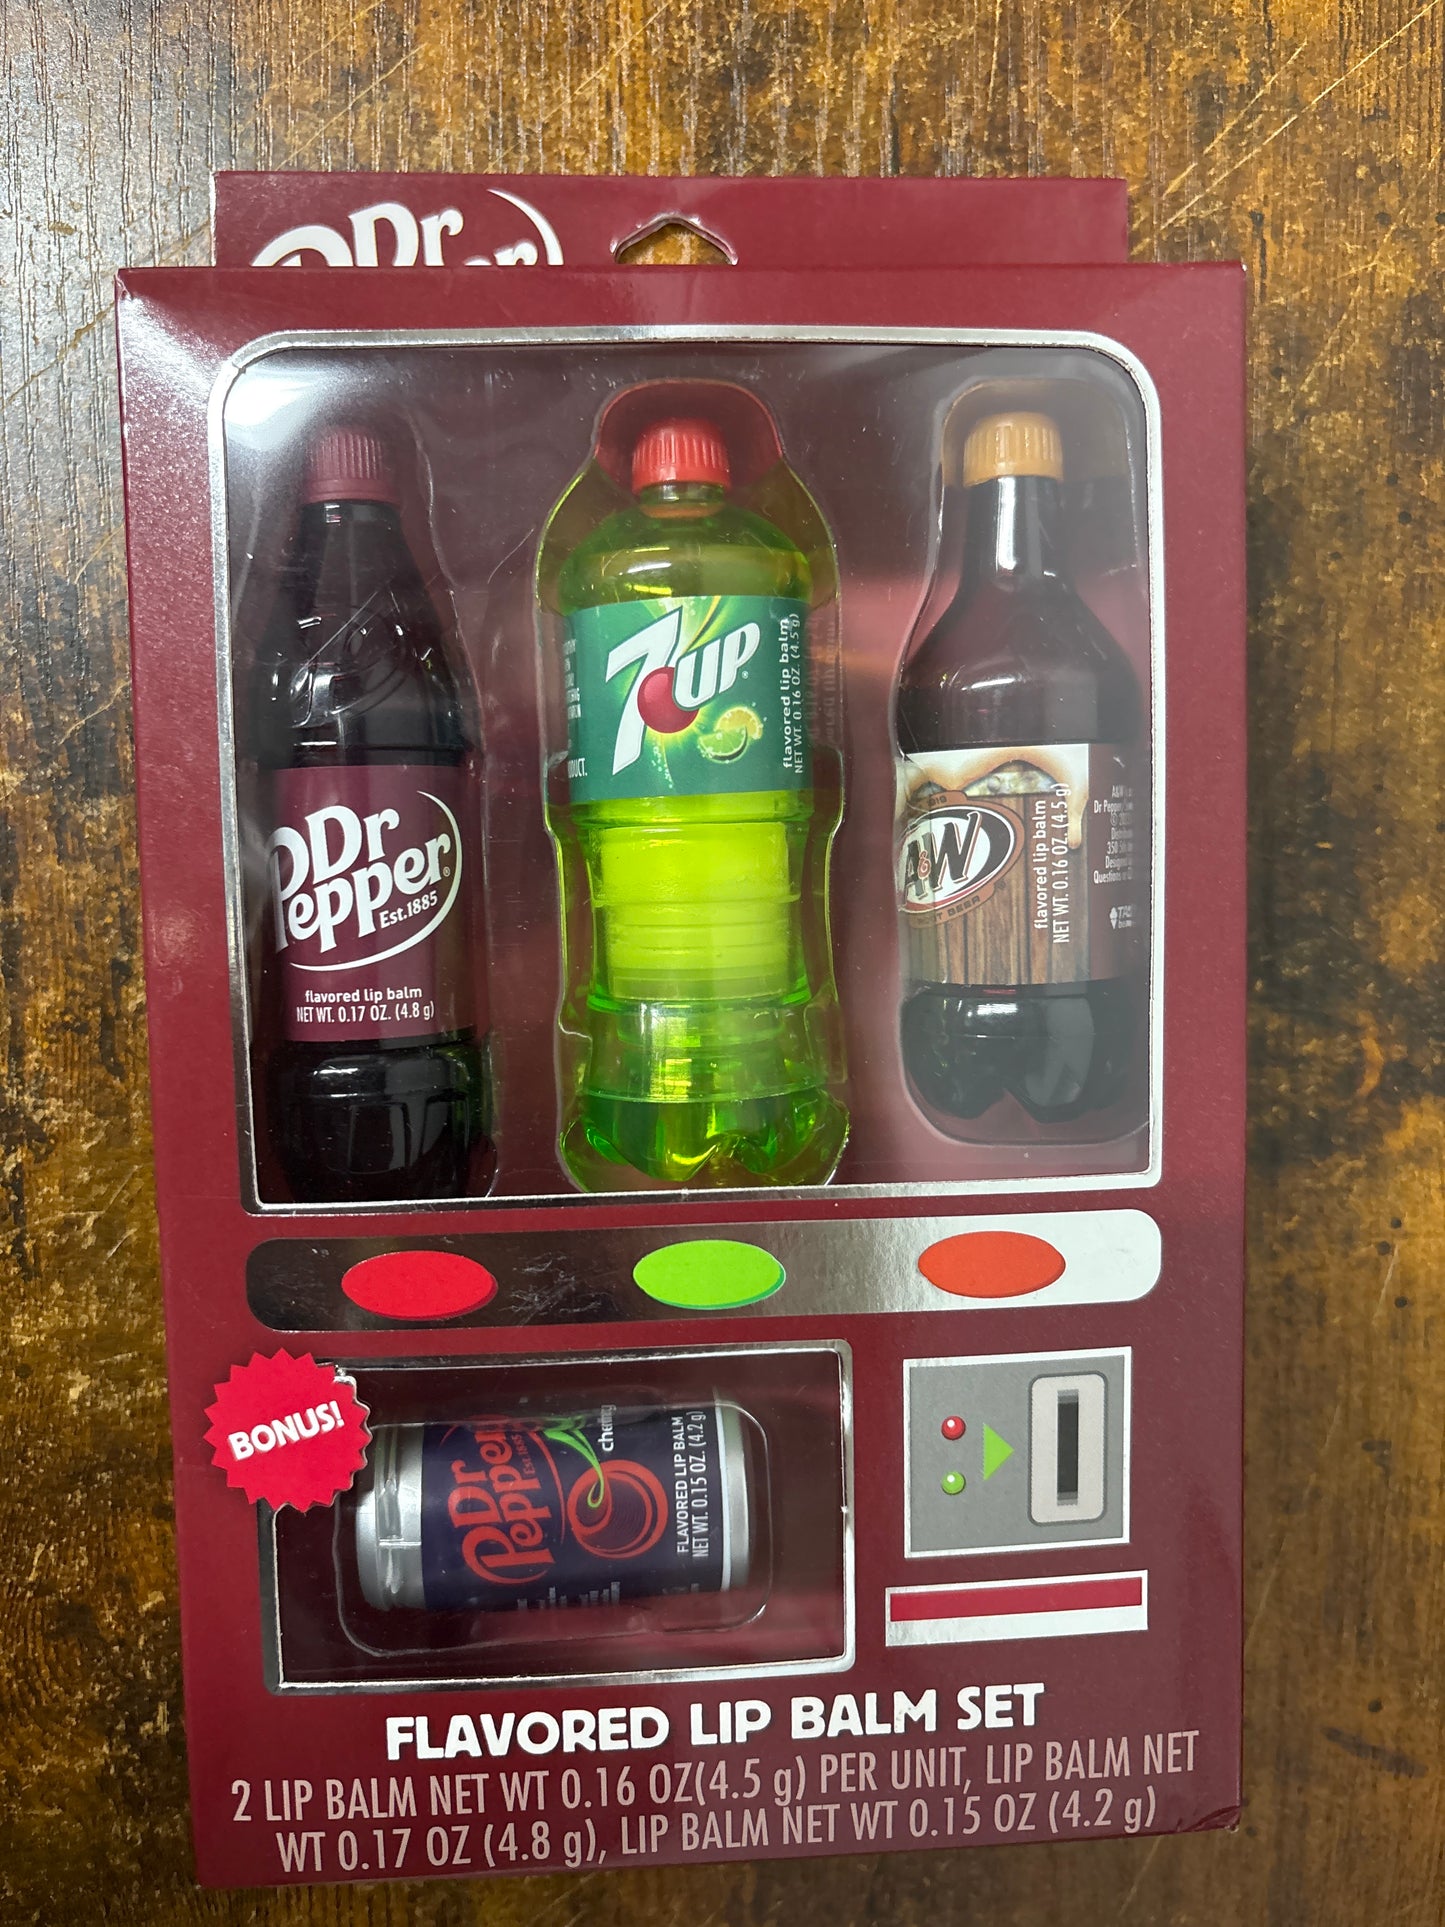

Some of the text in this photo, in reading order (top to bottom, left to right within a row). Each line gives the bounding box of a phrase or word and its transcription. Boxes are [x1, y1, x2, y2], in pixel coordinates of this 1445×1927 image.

[789, 631, 801, 660] (4.5
[605, 605, 761, 776] 7UP
[778, 618, 793, 769] flavored lip balm
[791, 664, 801, 686] OZ.
[792, 690, 803, 720] 0.16
[793, 725, 803, 748] WT.
[794, 751, 804, 774] NET
[1093, 800, 1103, 814] Dr
[305, 805, 400, 885] Dr
[903, 810, 982, 900] A&W
[1032, 800, 1049, 930] flavored lip balm
[1050, 783, 1072, 944] NET WT. 0.16 OZ. (4.5 g)
[265, 826, 452, 954] Pepper
[296, 1001, 435, 1023] NET WT. 0.17 OZ. (4.8 g)
[305, 986, 423, 1004] flavored lip balm
[228, 1400, 344, 1461] BONUS!
[687, 1423, 707, 1447] (4.2
[689, 1450, 707, 1473] OZ.
[448, 1459, 500, 1529] Dr
[671, 1416, 690, 1553] FLAVORED LIP BALM
[690, 1477, 708, 1507] 0.15
[692, 1511, 709, 1534] WT.
[692, 1536, 709, 1558] NET
[386, 1683, 1045, 1760] FLAVORED LIP BALM SET
[231, 1780, 252, 1821] 2
[265, 1779, 313, 1822] LIP
[326, 1776, 417, 1820] BALM
[430, 1773, 489, 1816] NET
[500, 1770, 550, 1812] WT
[561, 1766, 636, 1809] 0.16
[774, 1756, 807, 1806] g)
[820, 1751, 878, 1794] PER
[891, 1746, 972, 1794] UNIT,
[986, 1743, 1033, 1785] LIP
[1046, 1736, 1129, 1782] BALM
[1144, 1730, 1199, 1775] NET
[276, 1785, 1157, 1873] WT 0.17 OZ (4.8 g), LIP BALM NET WT 0.15 OZ (4.2 g)
